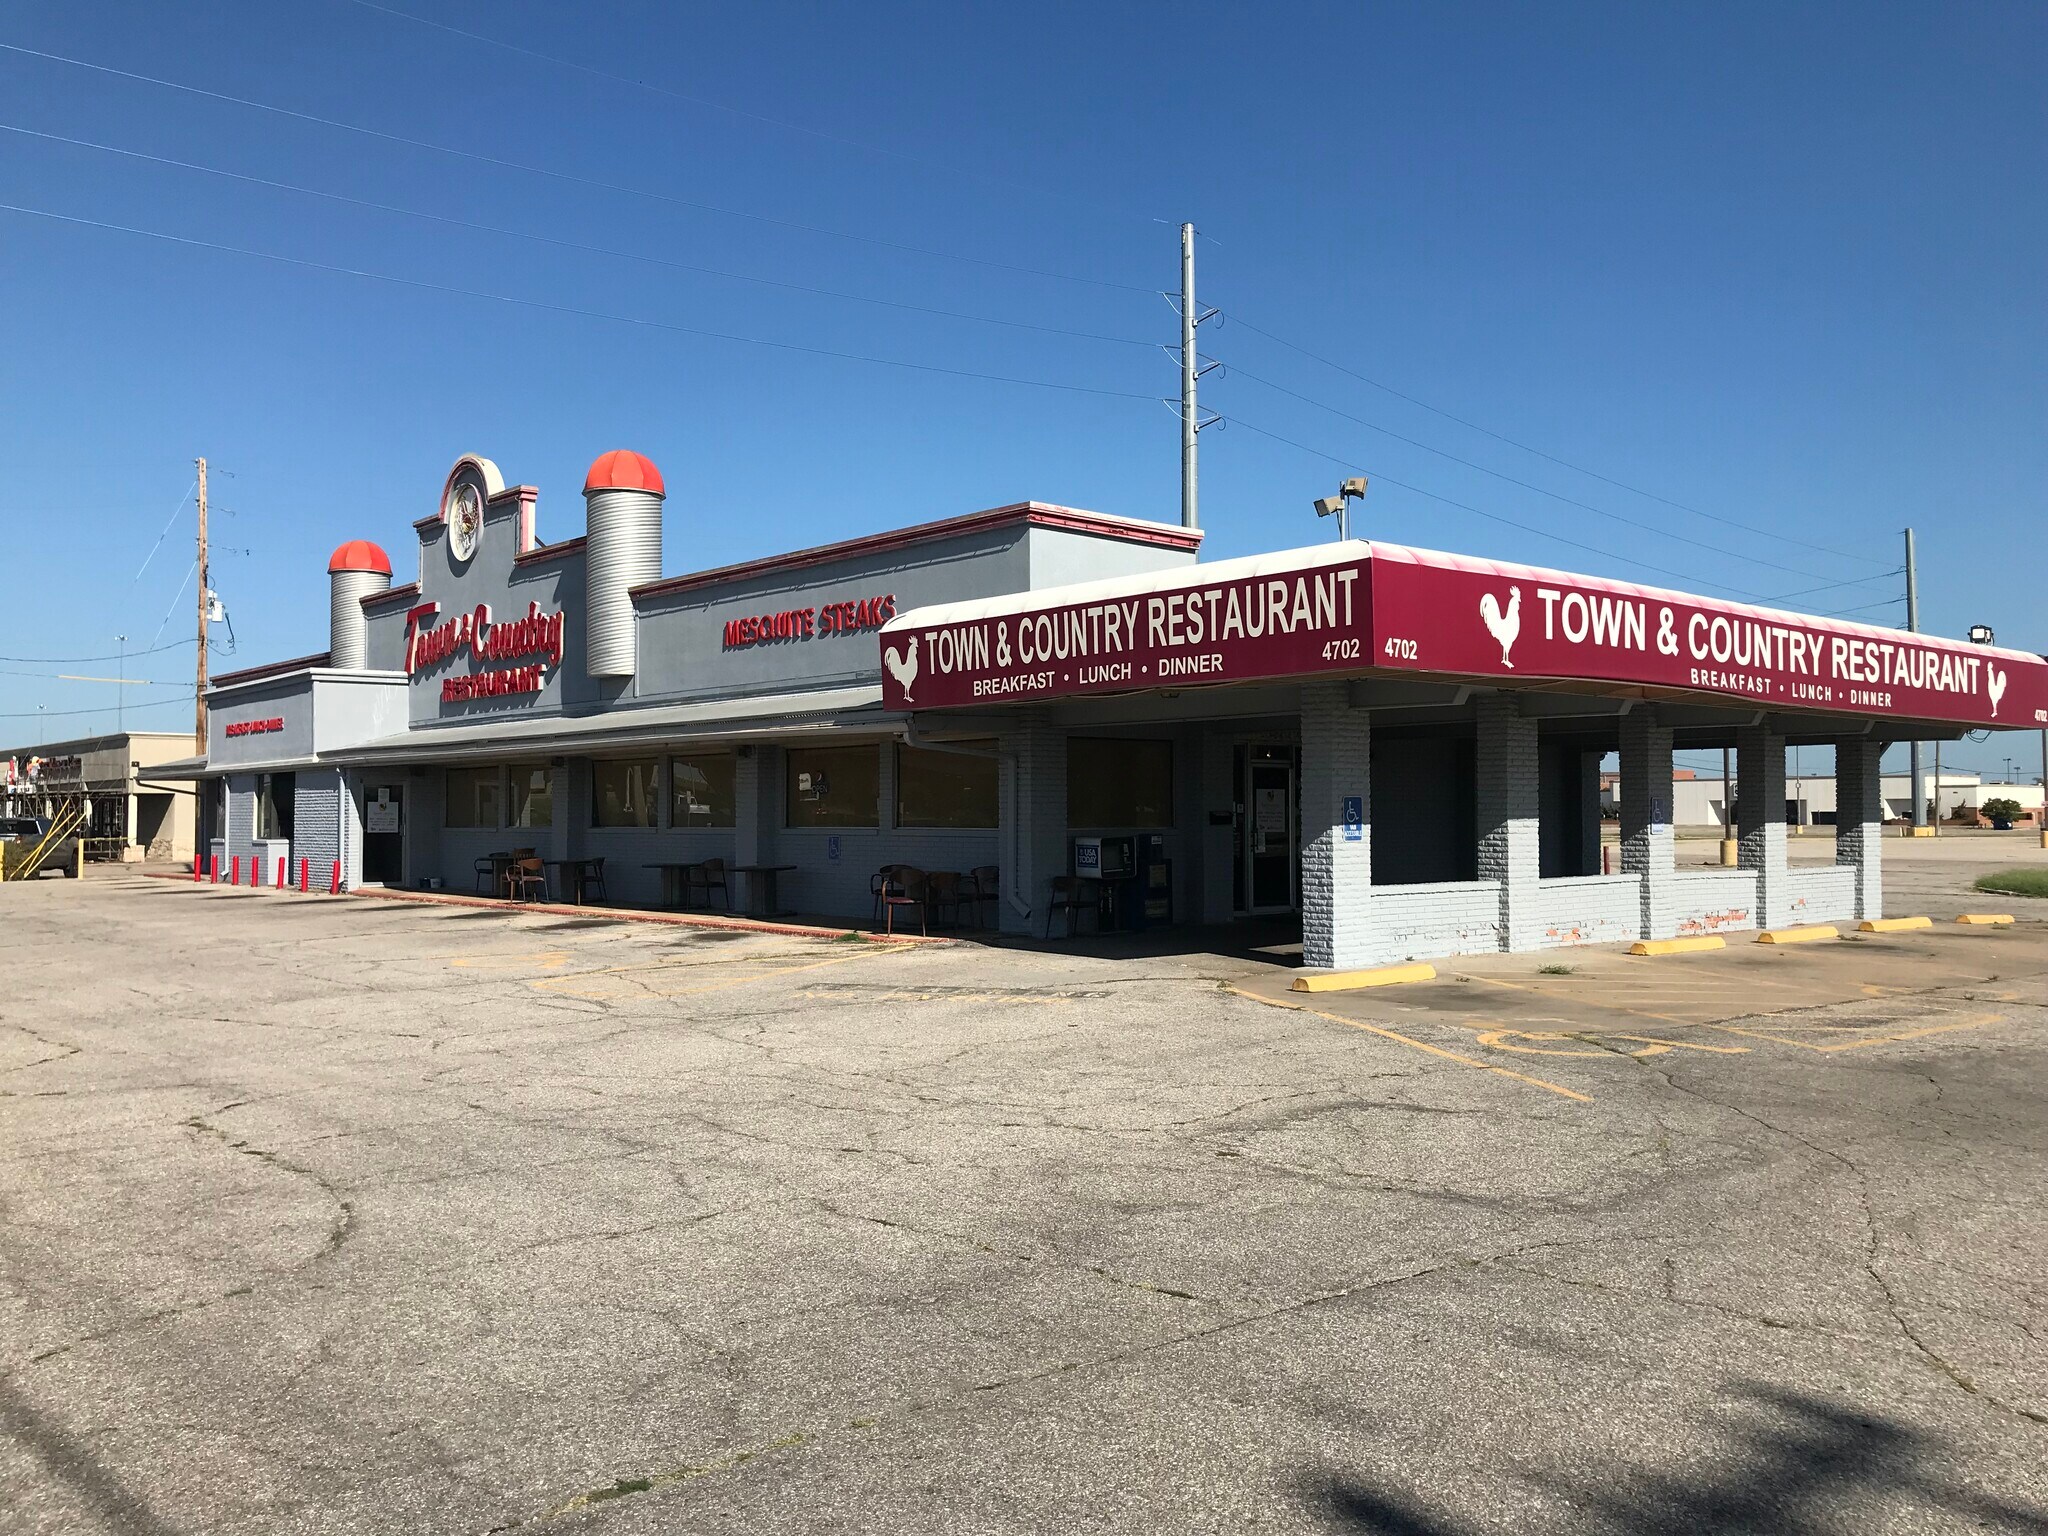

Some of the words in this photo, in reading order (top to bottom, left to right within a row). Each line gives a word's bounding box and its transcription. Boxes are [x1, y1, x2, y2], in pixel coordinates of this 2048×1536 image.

[404, 601, 462, 674] Town
[472, 600, 565, 668] Country
[724, 607, 816, 647] MESQUITE
[820, 593, 897, 633] STEAKS
[924, 624, 990, 675] TOWN
[997, 620, 1013, 668] &
[1018, 601, 1140, 664] COUNTRY
[1142, 568, 1359, 649] RESTAURANT
[1321, 638, 1360, 661] 4702
[1384, 637, 1418, 660] 4702
[1535, 588, 1647, 651] TOWN
[1656, 606, 1681, 657] &
[1688, 612, 1825, 676] COUNTRY
[1831, 637, 1981, 695] RESTAURANT
[442, 664, 548, 703] RESTAURANT
[973, 670, 1056, 698] BREAKFAST
[1078, 662, 1132, 685] LUNCH
[1158, 653, 1224, 677] DINNER
[1690, 667, 1772, 694] BREAKFAST
[1791, 682, 1832, 702] LUNCH
[1850, 689, 1892, 708] DINNER
[811, 784, 828, 793] OPEN
[1078, 855, 1097, 864] TODAY
[1084, 848, 1096, 856] USA
